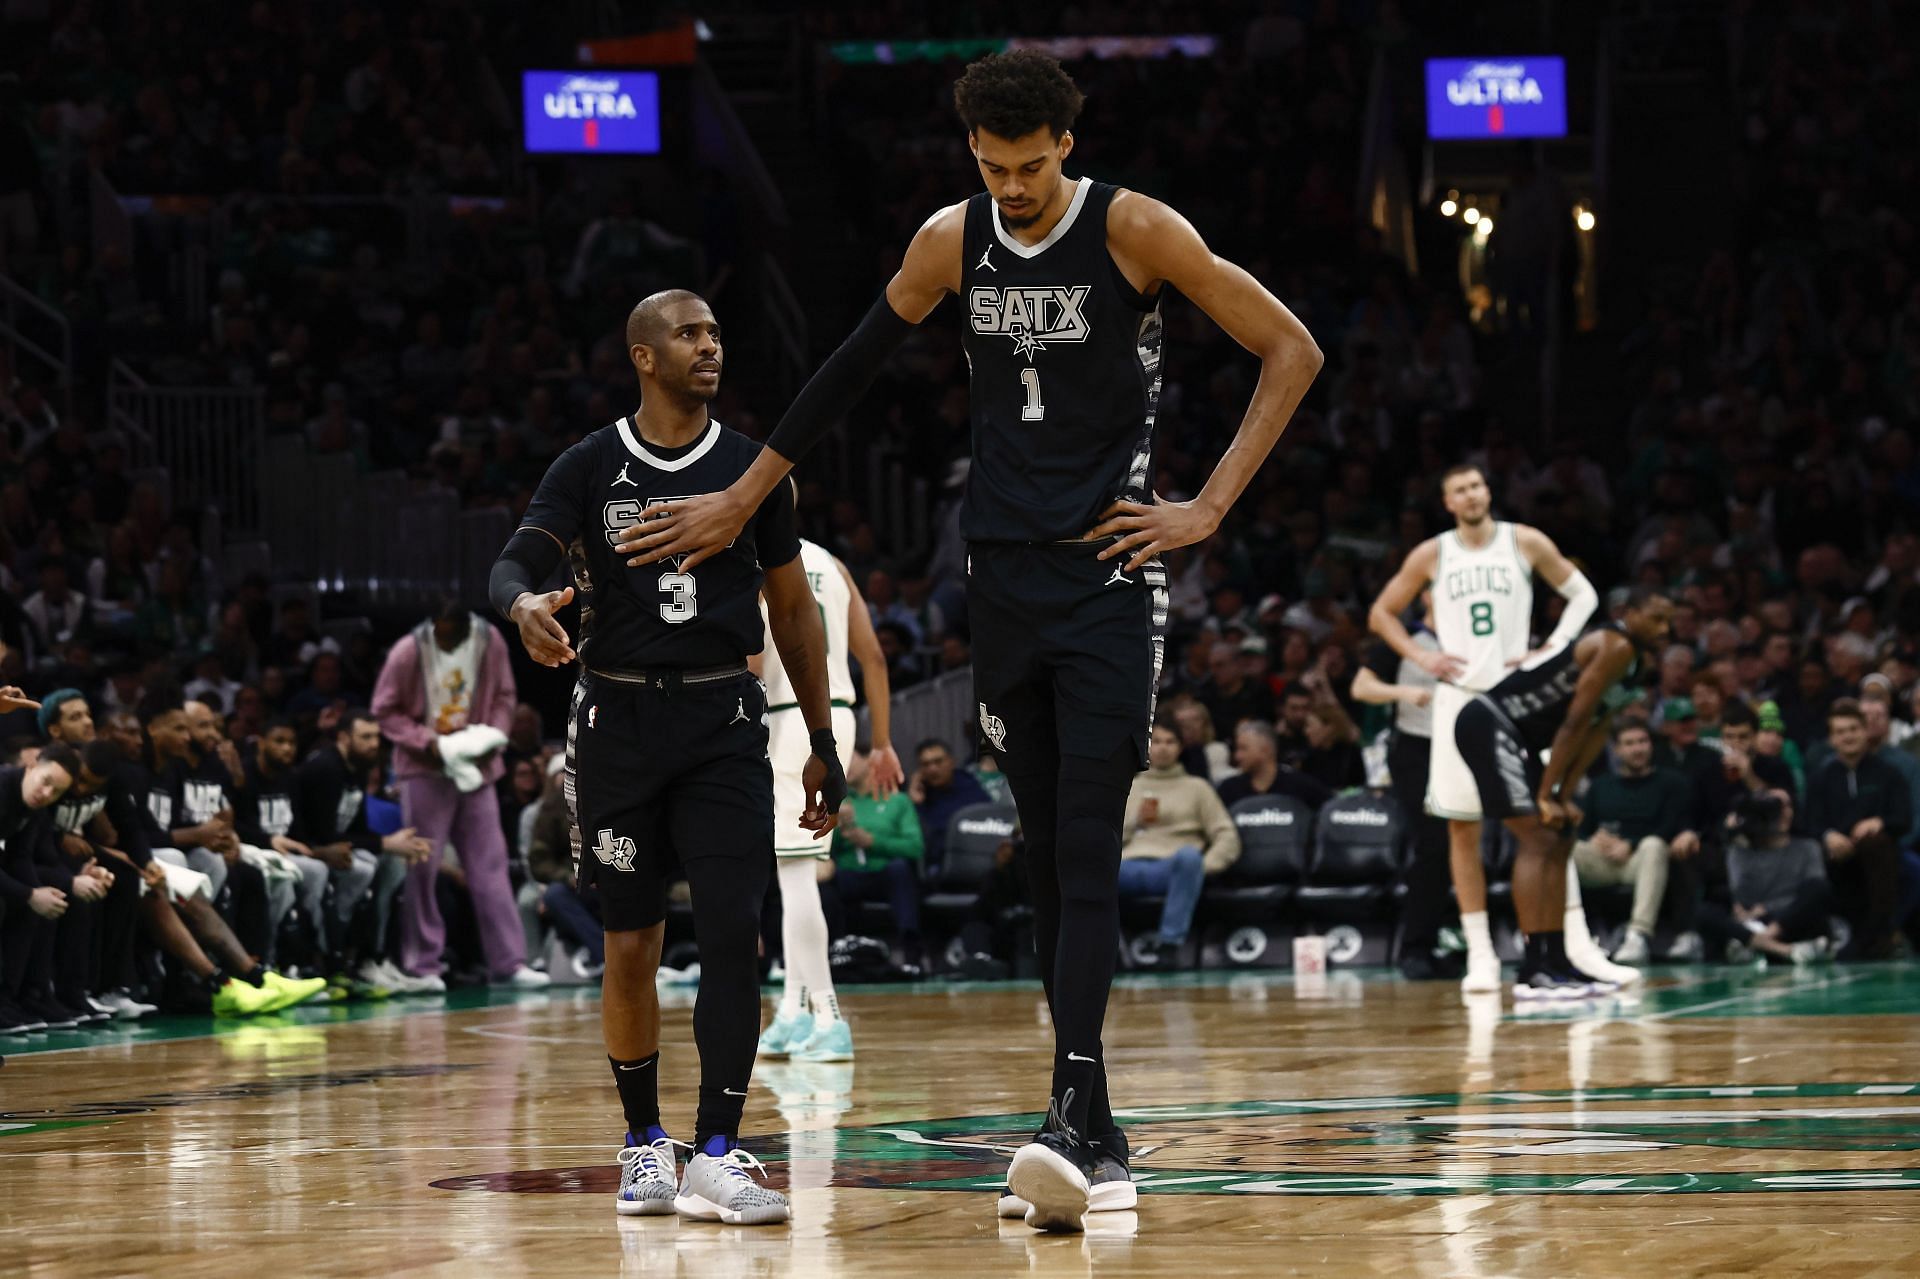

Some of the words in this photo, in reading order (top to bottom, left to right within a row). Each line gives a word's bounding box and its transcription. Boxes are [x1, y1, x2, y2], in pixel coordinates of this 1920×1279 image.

[543, 92, 637, 119] ULTRA
[1446, 77, 1543, 106] ULTRA
[970, 286, 1092, 343] SATX
[1020, 367, 1045, 421] 1
[657, 571, 698, 624] 3
[1446, 566, 1513, 601] CELTICS
[1470, 602, 1494, 635] 8
